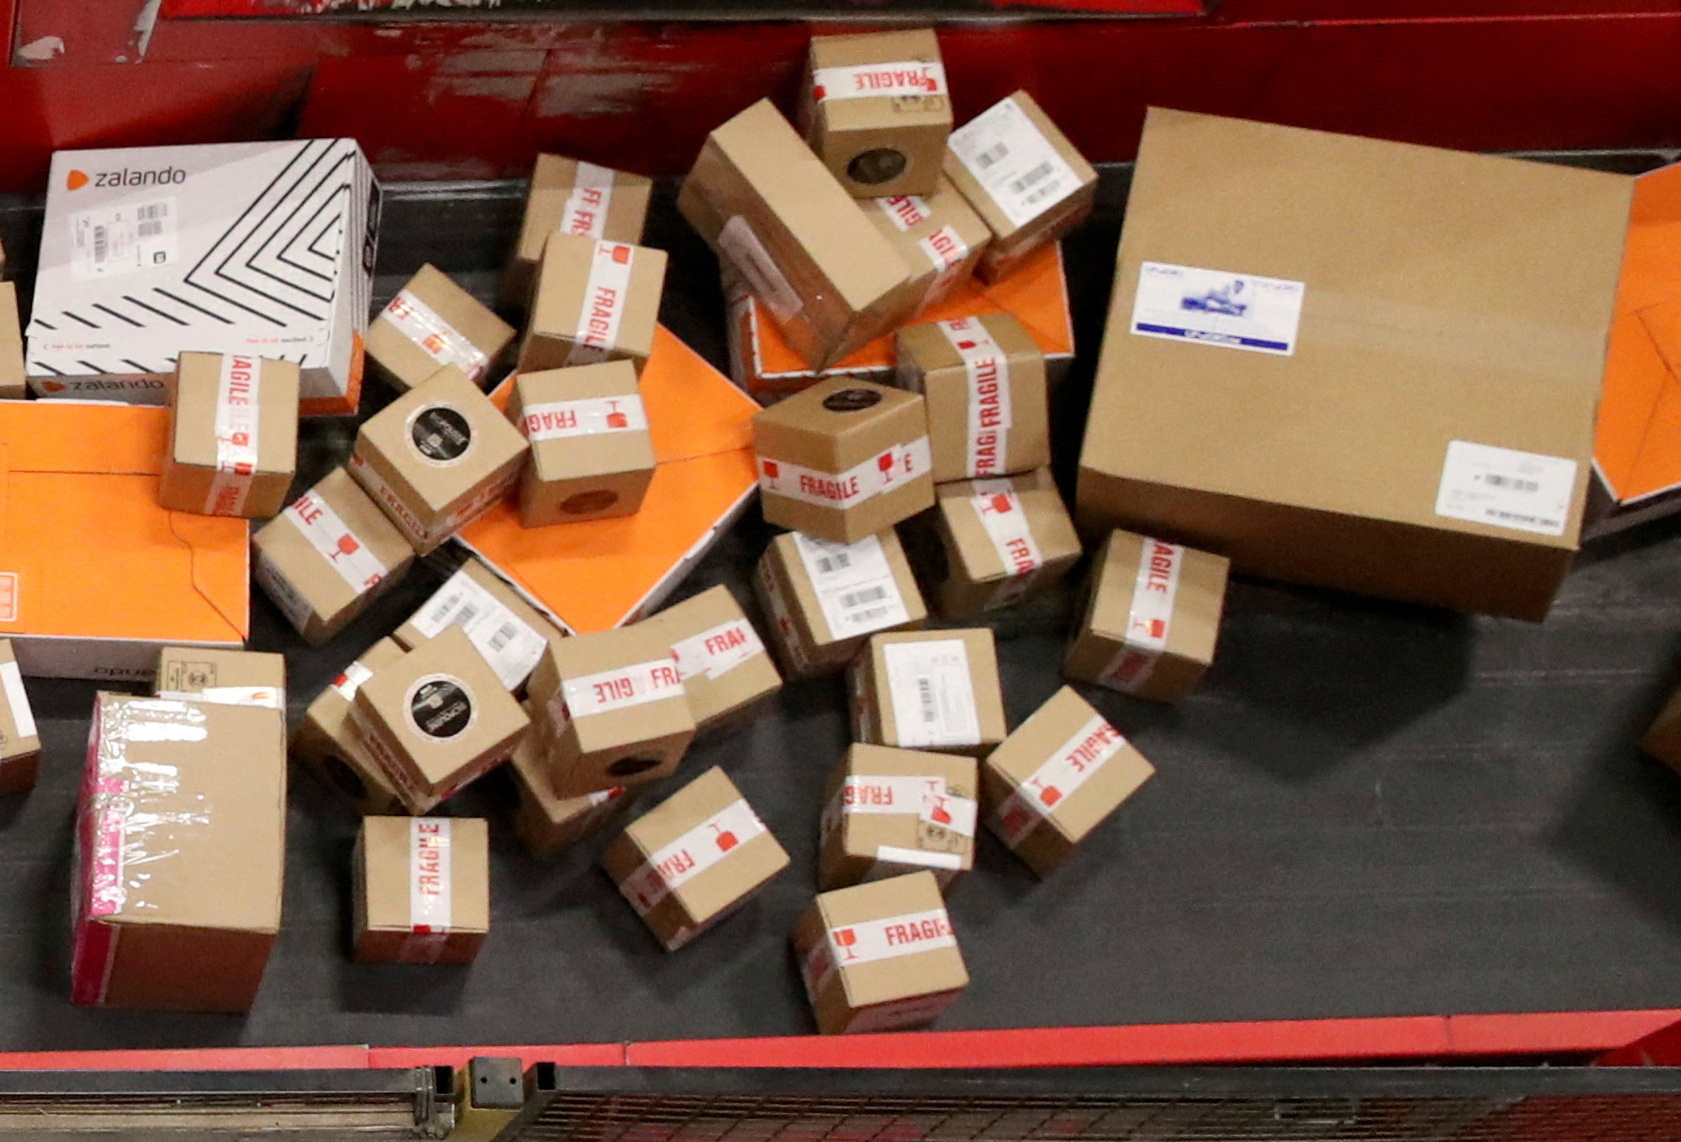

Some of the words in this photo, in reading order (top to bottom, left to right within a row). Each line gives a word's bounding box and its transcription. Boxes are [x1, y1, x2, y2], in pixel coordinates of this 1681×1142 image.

[94, 166, 187, 188] zalando
[71, 376, 166, 392] zalando
[975, 356, 1002, 428] FRAGILE
[800, 475, 860, 501] FRAGILE
[418, 823, 440, 896] FRAGILE
